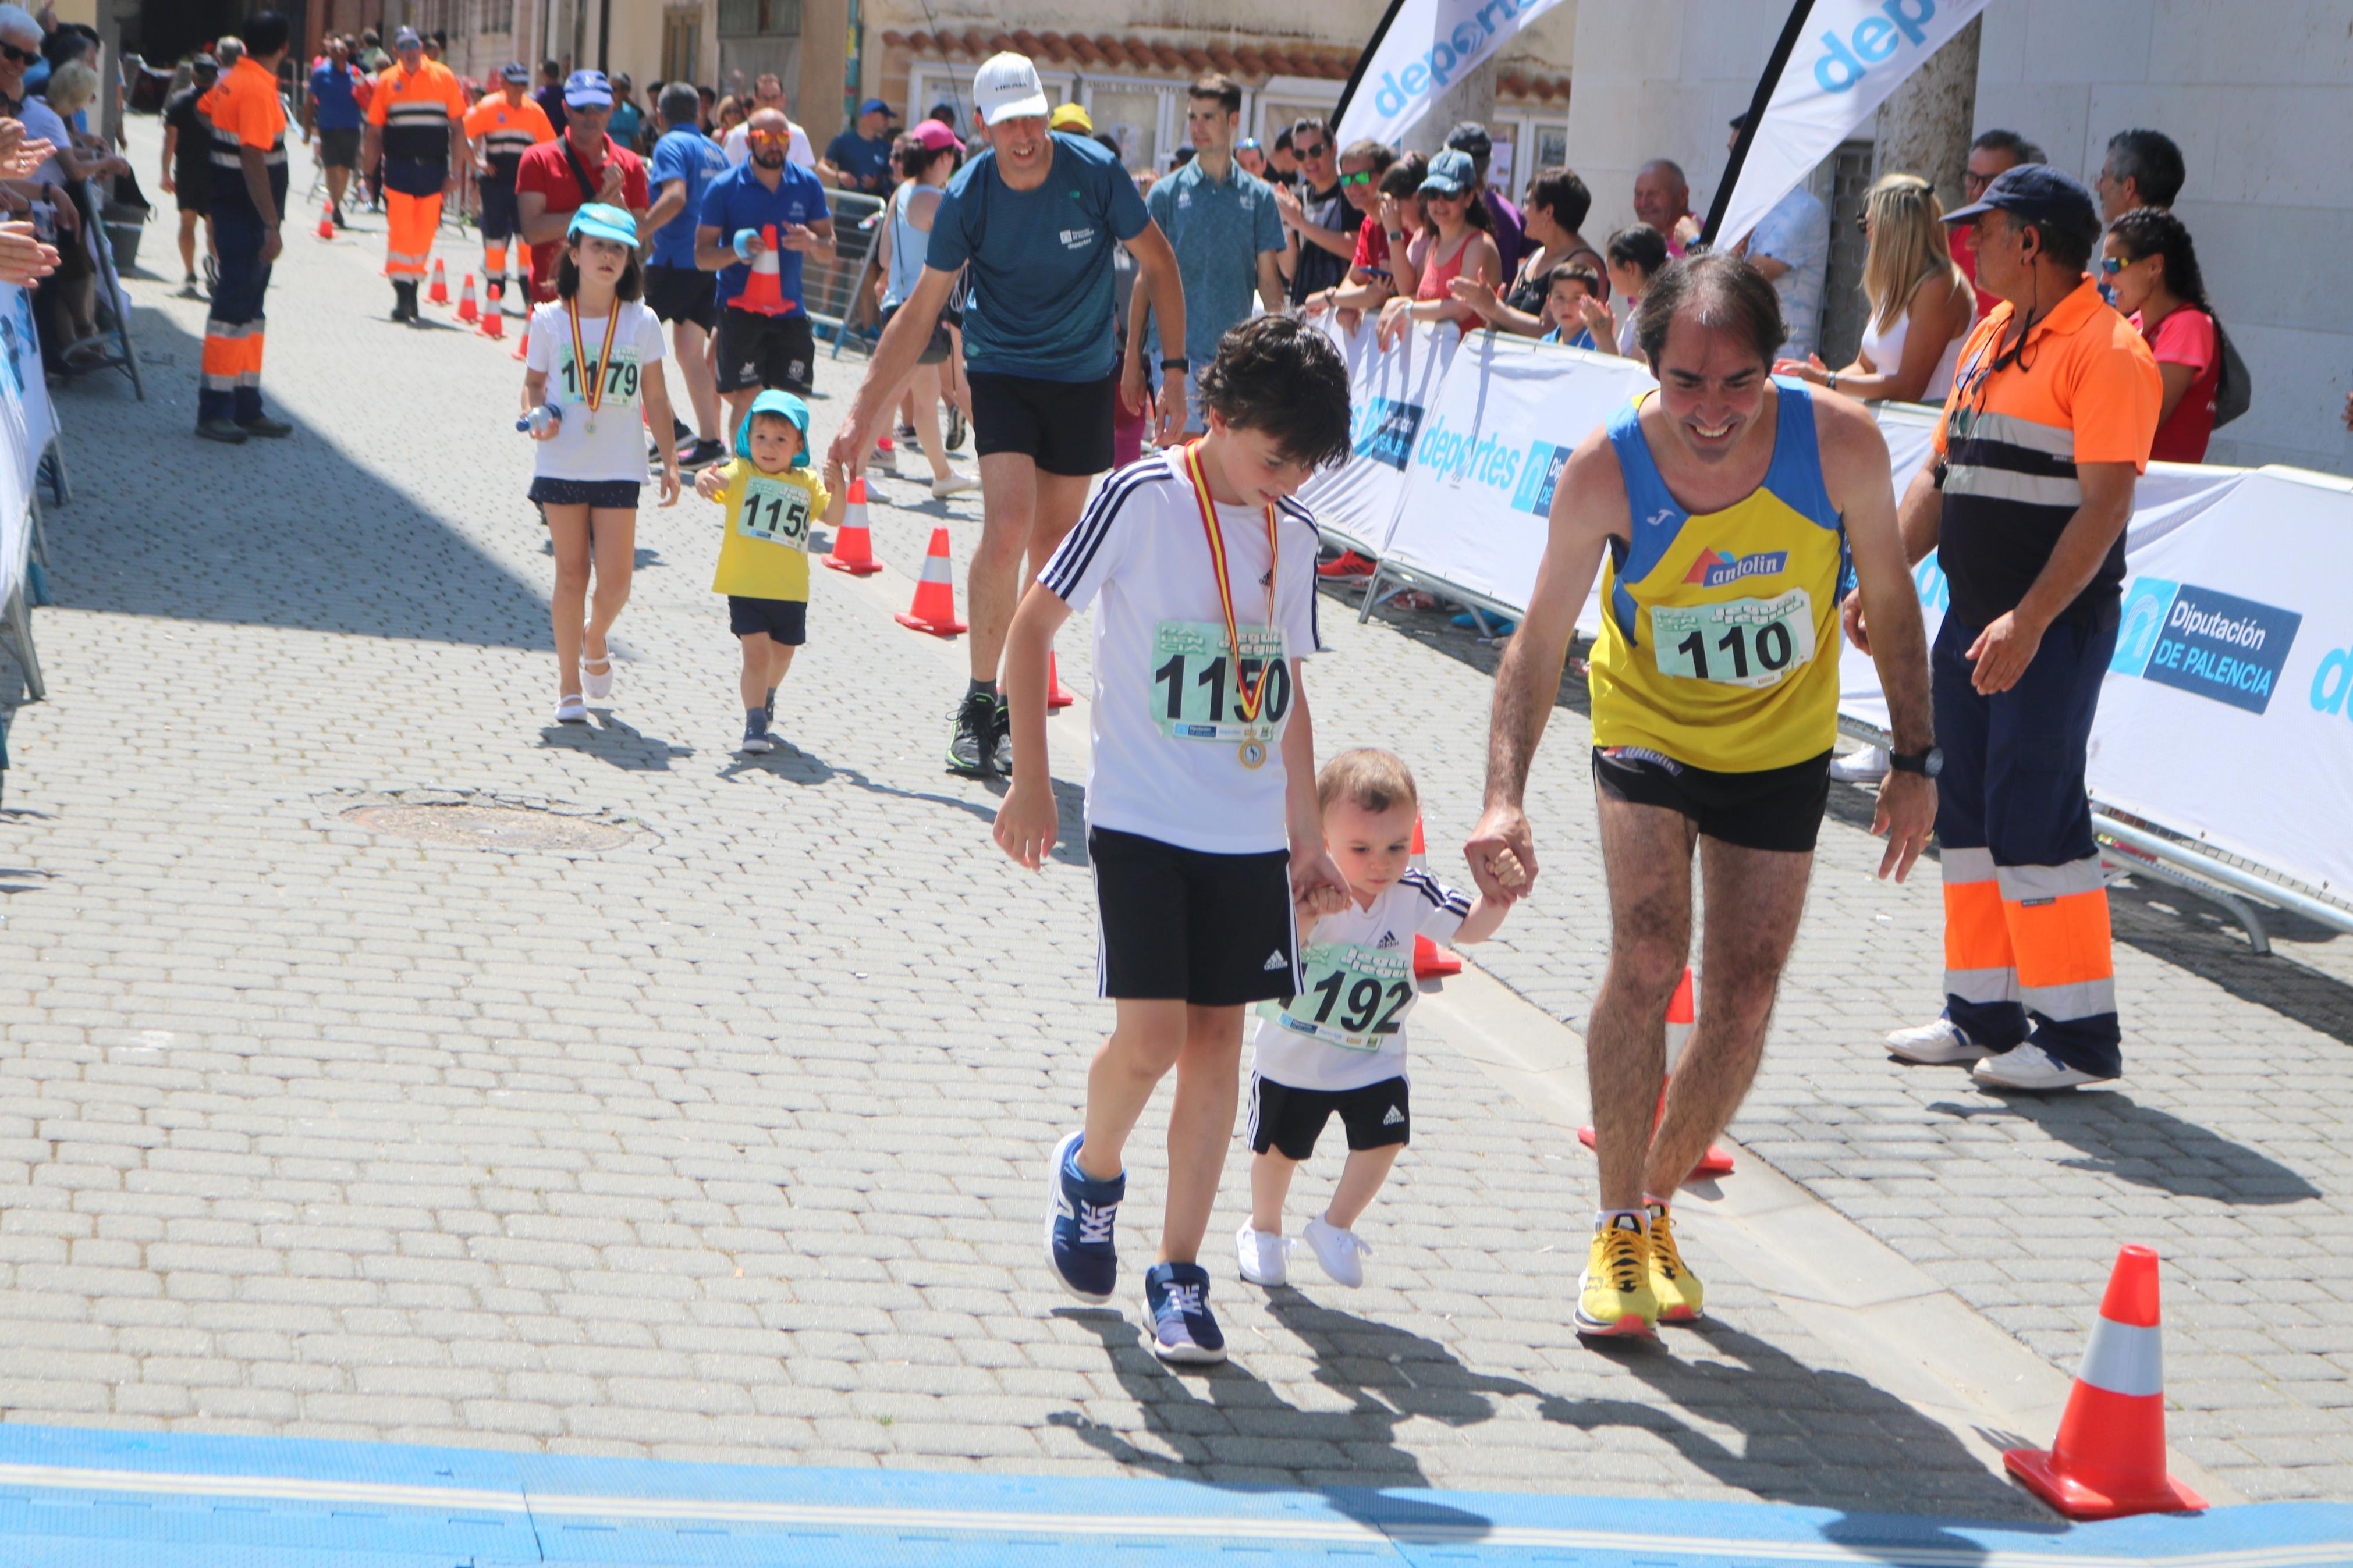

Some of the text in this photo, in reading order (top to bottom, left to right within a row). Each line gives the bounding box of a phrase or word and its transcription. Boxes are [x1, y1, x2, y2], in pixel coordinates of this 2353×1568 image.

[561, 360, 638, 397] 1179
[1418, 414, 1520, 490] deportes
[1712, 555, 1777, 585] antolin
[2170, 600, 2266, 650] Diputación
[1678, 621, 1792, 680] 110
[2154, 639, 2272, 696] DE PALENCIA
[1155, 653, 1291, 723] 1150
[1264, 960, 1289, 971] adidas
[1377, 939, 1400, 950] adidas
